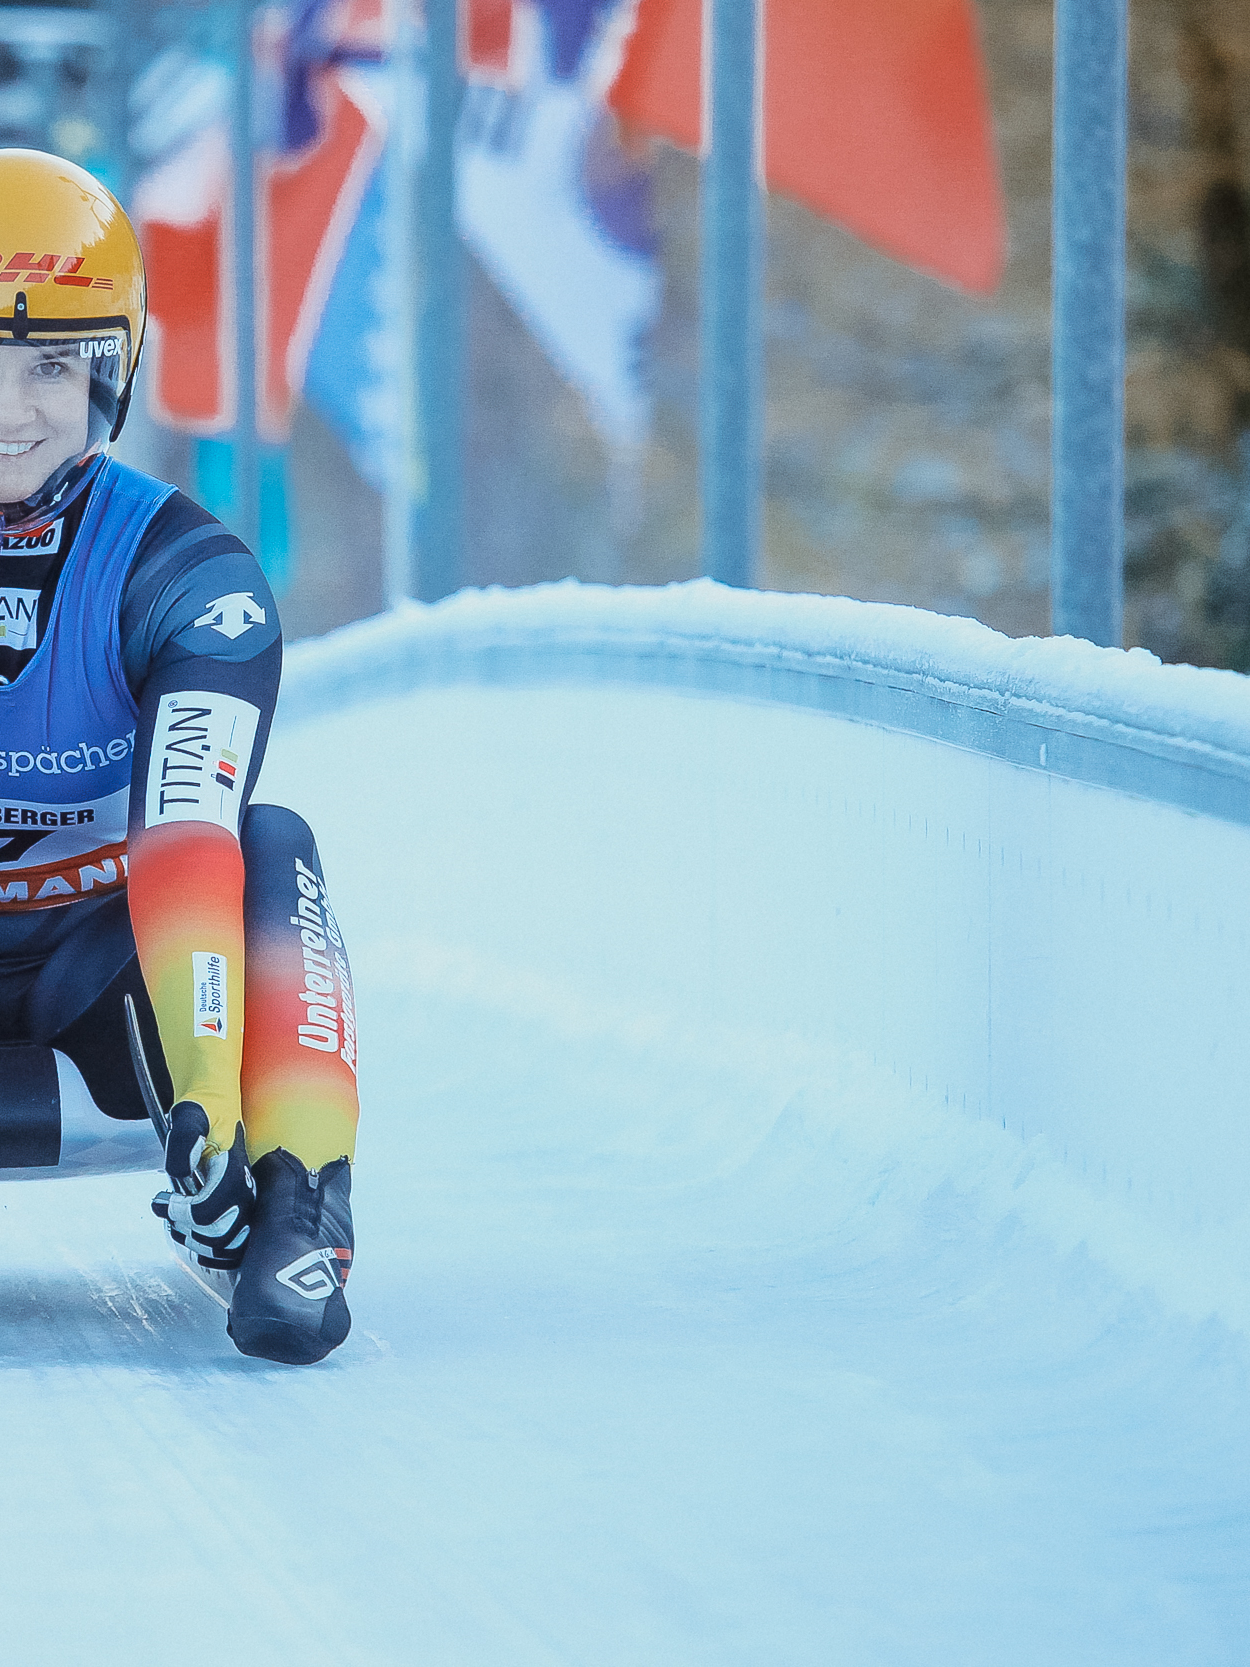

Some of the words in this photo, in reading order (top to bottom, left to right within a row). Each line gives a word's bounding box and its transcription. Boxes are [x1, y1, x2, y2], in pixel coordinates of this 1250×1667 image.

[79, 338, 123, 358] uvex
[159, 706, 213, 816] TITAN
[290, 857, 339, 1053] Unterreiner
[198, 981, 207, 1013] Deutsche
[207, 956, 224, 1013] Sporthilfe
